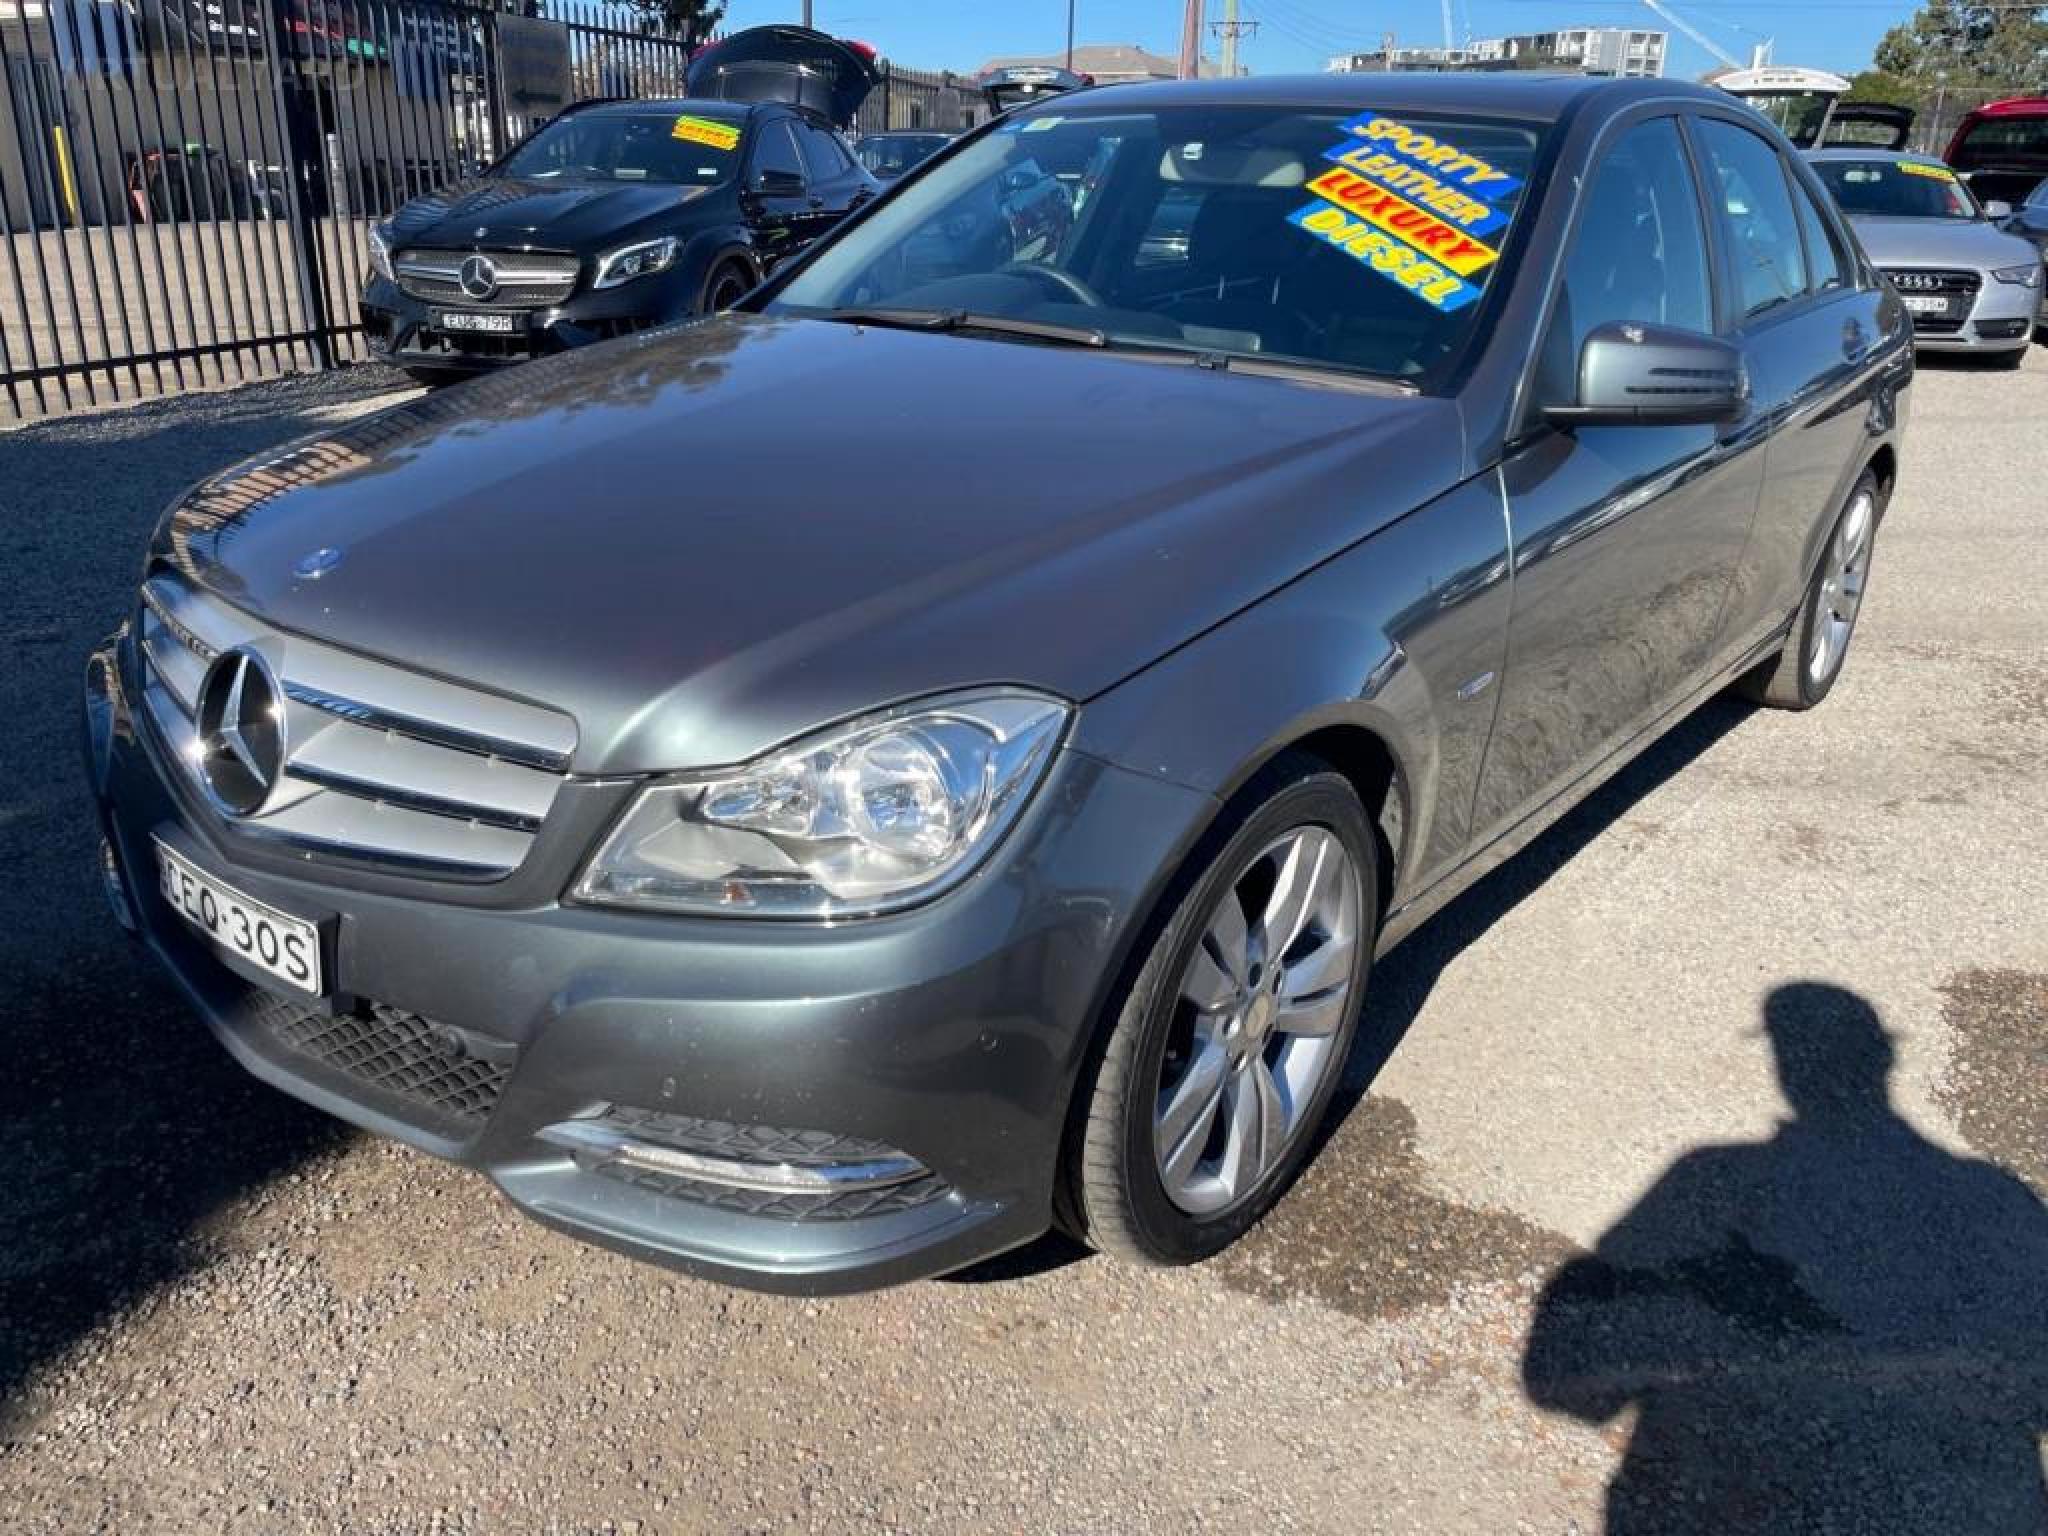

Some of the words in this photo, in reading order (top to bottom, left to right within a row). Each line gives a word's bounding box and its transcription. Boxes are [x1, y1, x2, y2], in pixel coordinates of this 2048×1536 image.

[1340, 146, 1491, 226] LEATHER
[1353, 117, 1508, 185] SPORTY
[1300, 207, 1463, 306] DIESEL
[1318, 172, 1490, 260] LUXURY
